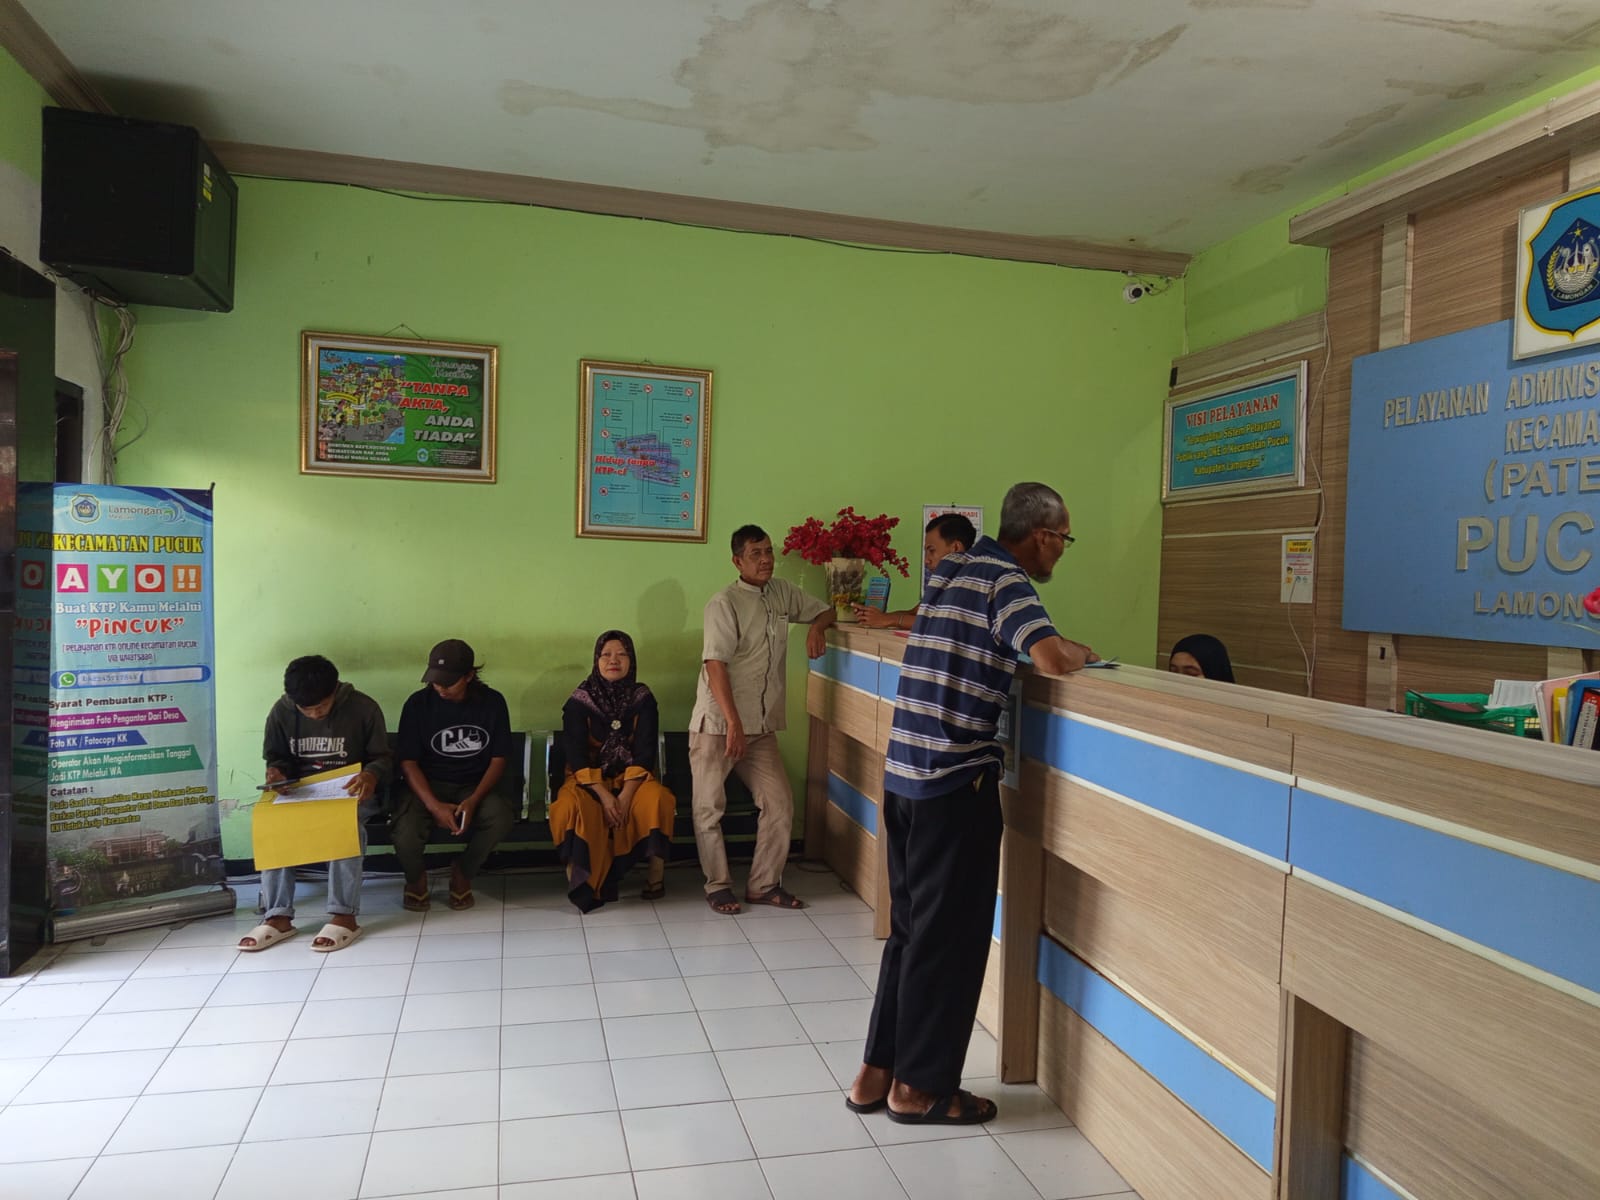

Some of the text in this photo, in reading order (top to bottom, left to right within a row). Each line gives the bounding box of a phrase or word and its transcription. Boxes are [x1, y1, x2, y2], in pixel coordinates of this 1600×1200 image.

[1556, 284, 1594, 299] LAMONGAN
[398, 397, 449, 412] AKTA,
[1186, 394, 1279, 428] VISI PELAYANAN
[1384, 382, 1490, 428] PELAYANAN
[425, 415, 474, 428] ANDA
[1504, 410, 1600, 455] KECAMA
[1267, 434, 1290, 447] Pucuk
[108, 505, 162, 516] Lamongan
[53, 533, 149, 552] KECAMATAN
[153, 536, 204, 553] PUCUK
[55, 601, 201, 614] Buat KTP Kamu Melalui
[1474, 591, 1600, 621] LAMON
[49, 700, 82, 710] Syarat
[86, 696, 144, 706] Pembuatan
[148, 694, 167, 703] KTP
[50, 710, 179, 730] Mengirimkan Foto Pengantar Dari Desa
[50, 739, 65, 748] Foto
[67, 737, 77, 746] KK
[84, 735, 116, 747] Fotocopy
[117, 733, 128, 742] KK
[51, 758, 81, 769] Operator
[83, 755, 100, 765] Akan
[166, 748, 192, 760] Tanggal
[67, 771, 81, 780] KTP
[82, 768, 108, 778] Melalui
[110, 767, 122, 775] WA
[50, 787, 87, 797] Catatan
